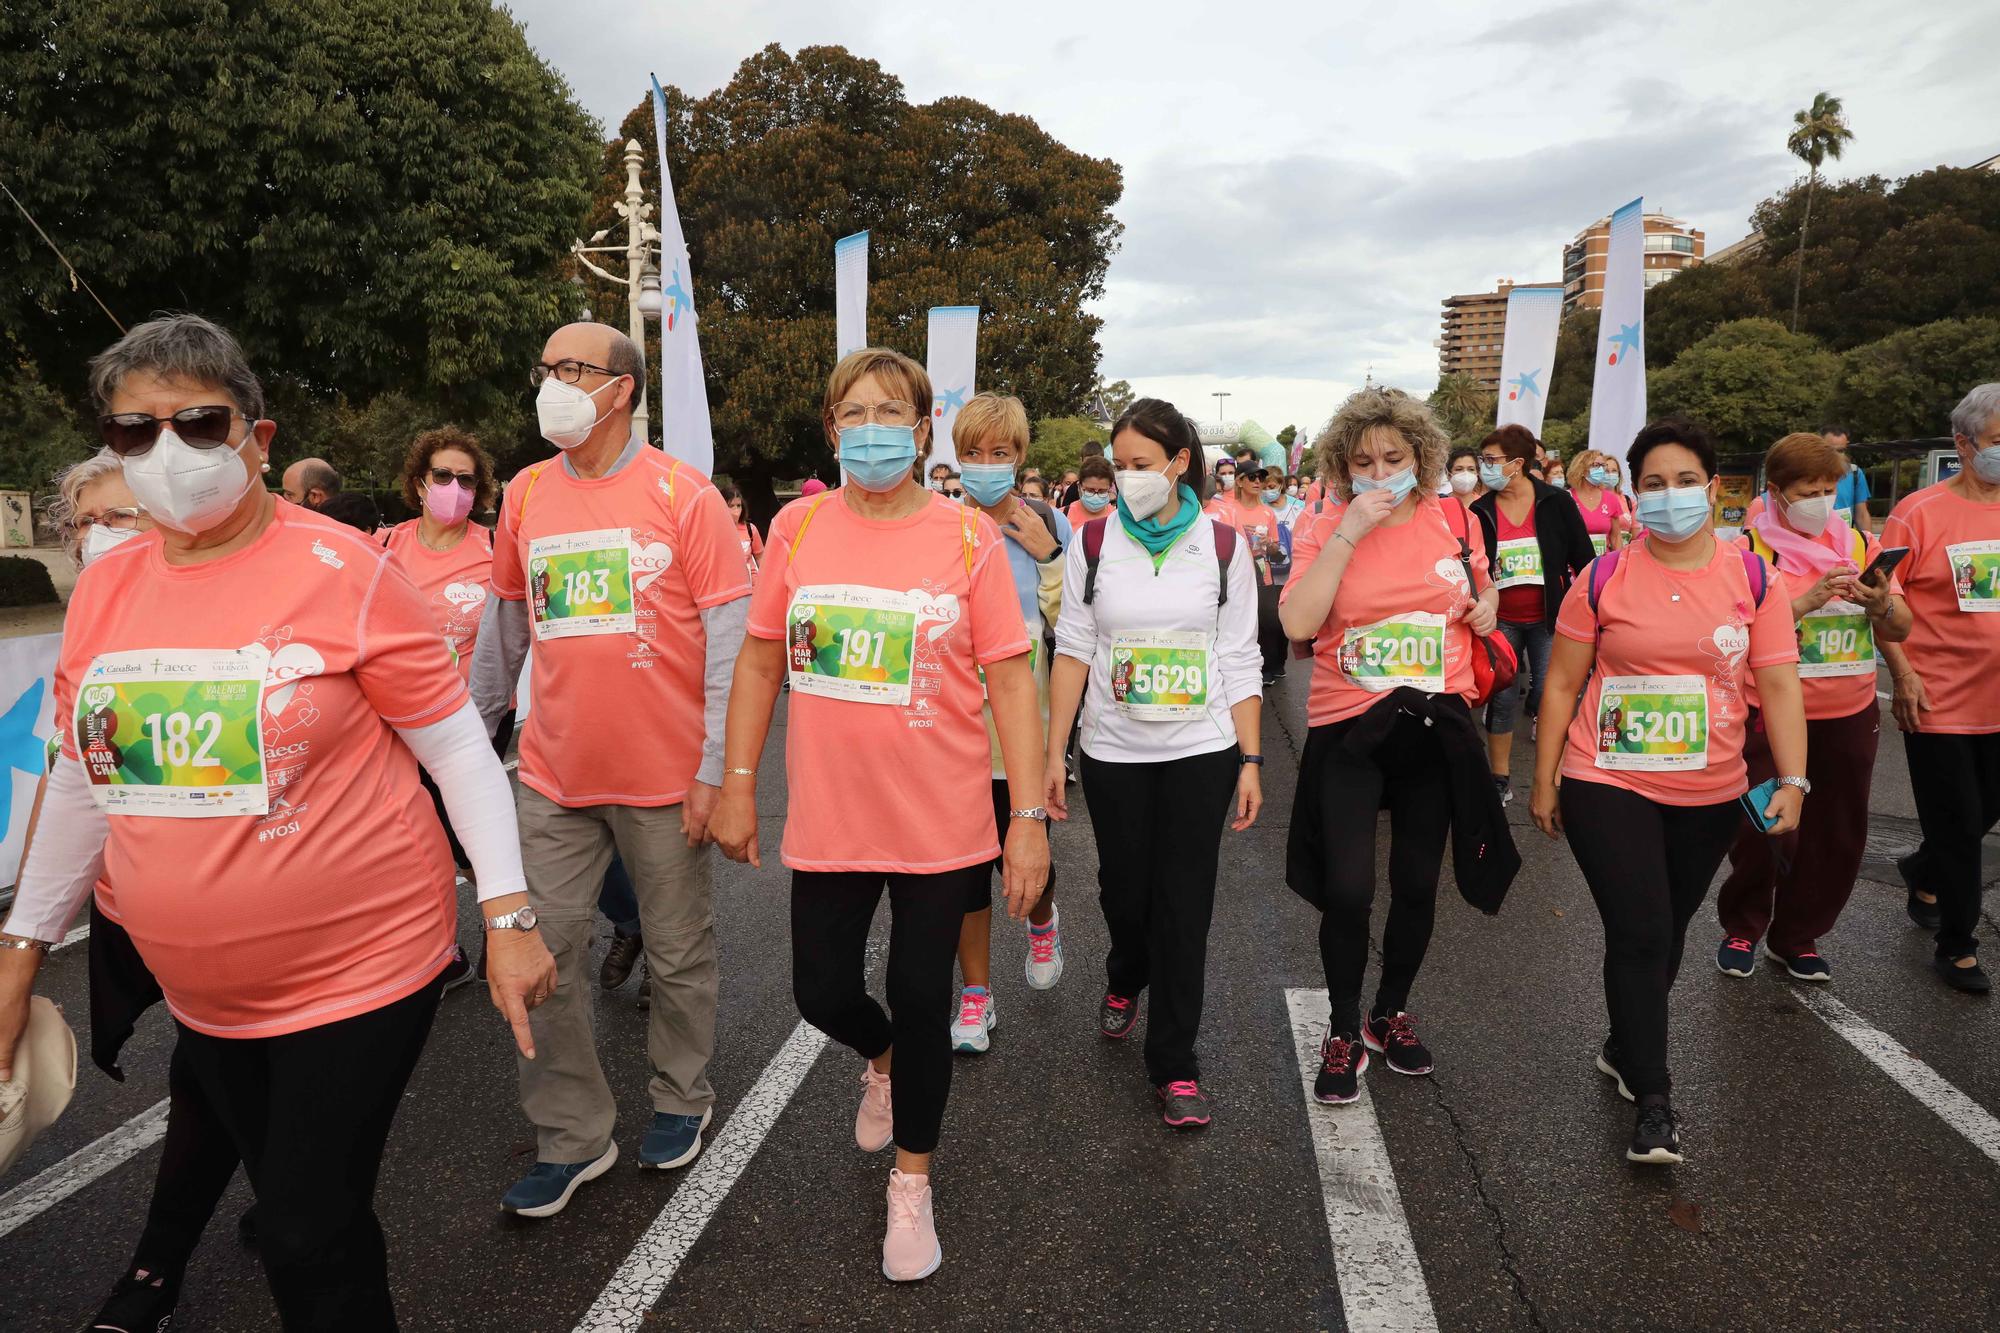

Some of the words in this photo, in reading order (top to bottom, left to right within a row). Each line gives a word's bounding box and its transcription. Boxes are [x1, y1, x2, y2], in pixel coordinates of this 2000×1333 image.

[631, 556, 667, 570] ecc
[564, 568, 611, 607] 183
[448, 592, 483, 601] aecc
[636, 609, 656, 617] ecc
[919, 604, 958, 620] ecc
[840, 628, 885, 669] 191
[1817, 628, 1857, 655] 190
[794, 648, 812, 657] MAR
[1364, 636, 1438, 667] 5200
[107, 662, 142, 673] CaixaBank
[164, 664, 197, 672] aecc
[795, 656, 812, 666] CHA
[1134, 664, 1203, 696] 5629
[1626, 711, 1697, 743] 5201
[145, 711, 221, 768] 182
[1602, 731, 1617, 740] MAR
[1602, 738, 1616, 747] CHA
[88, 751, 115, 763] MAR
[265, 740, 310, 760] aecc
[92, 763, 118, 776] CHA
[258, 820, 300, 843] #YOSI
